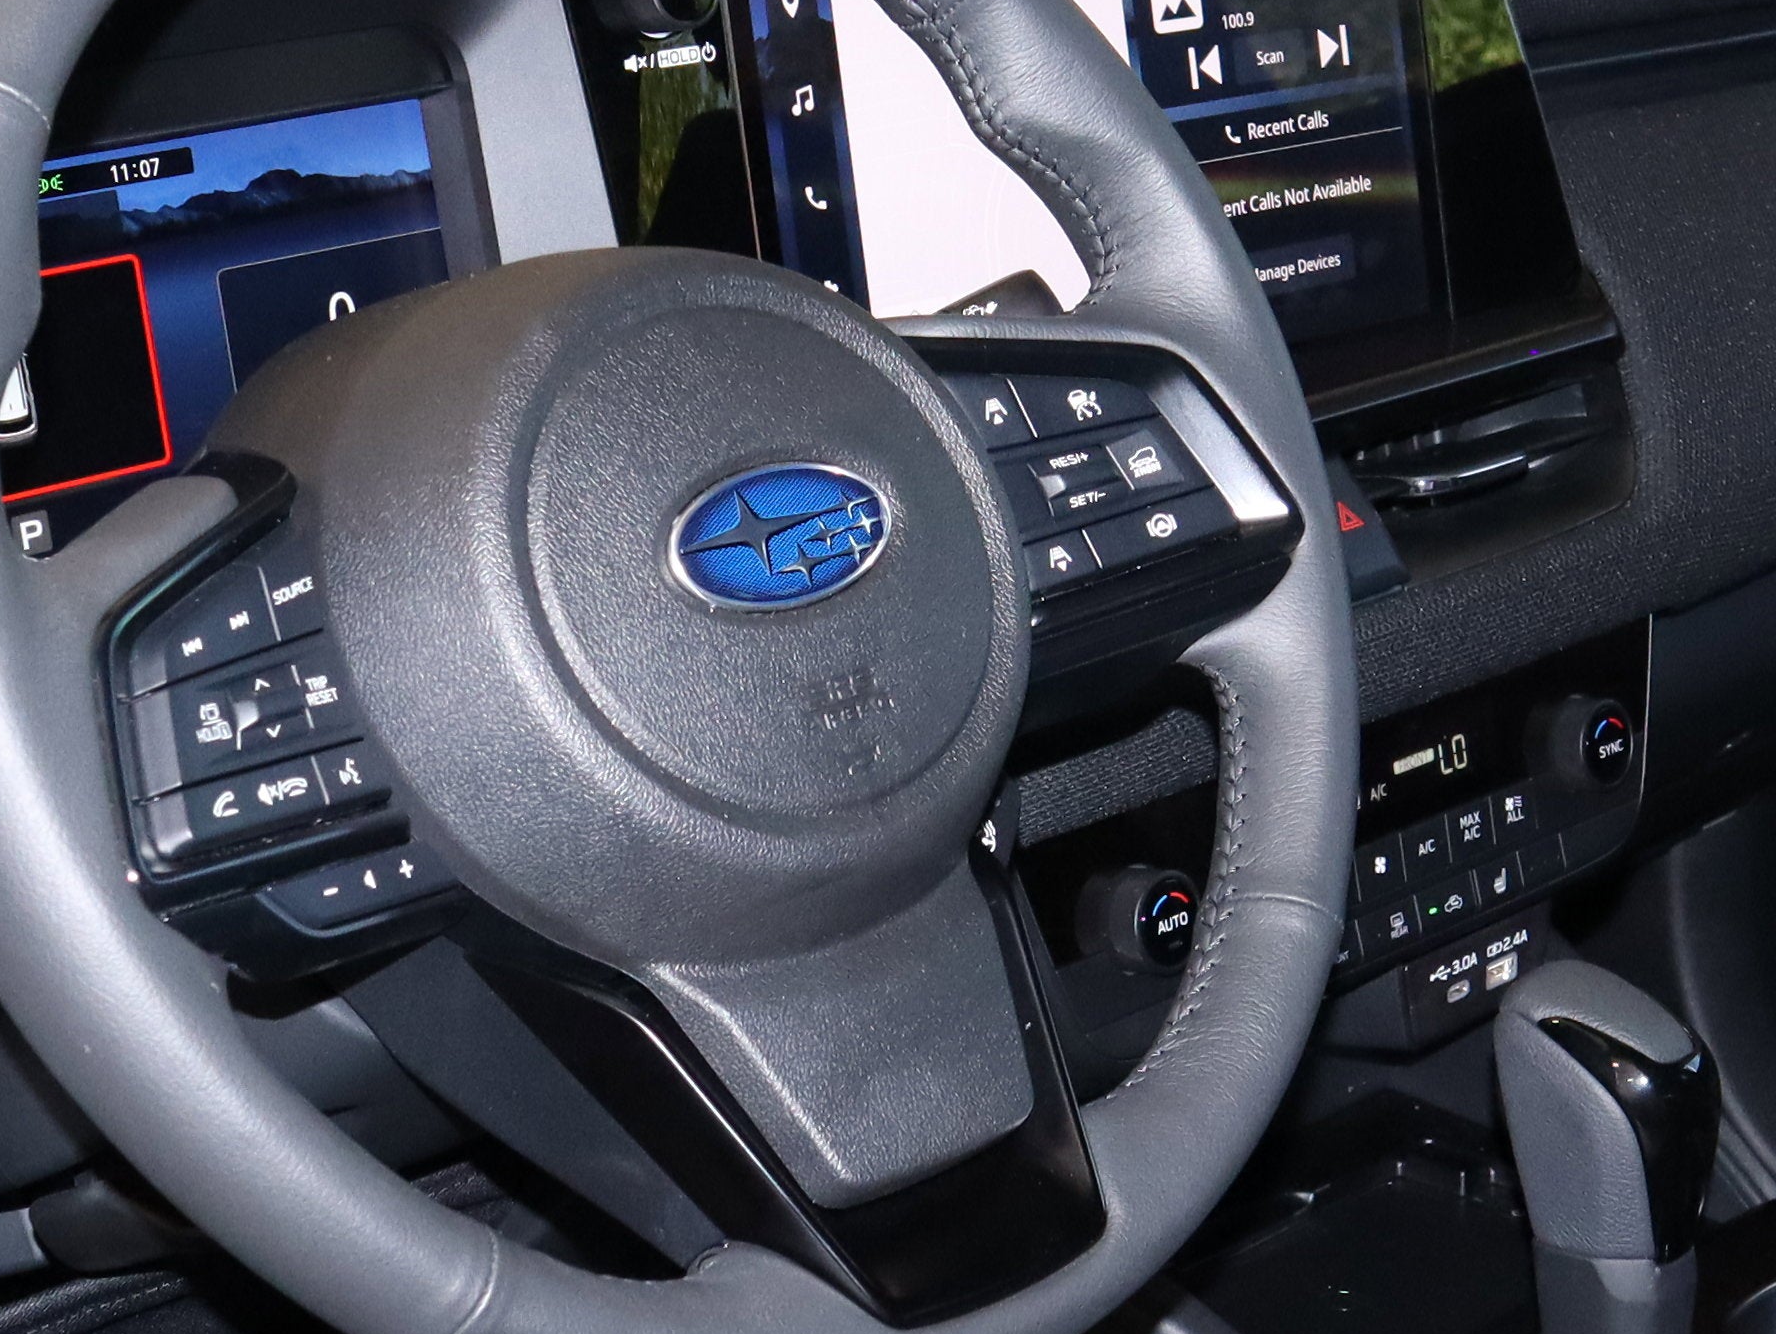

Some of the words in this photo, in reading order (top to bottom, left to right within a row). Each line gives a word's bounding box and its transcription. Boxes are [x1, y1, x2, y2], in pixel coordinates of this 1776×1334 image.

[1221, 11, 1255, 31] 100.9
[1256, 49, 1285, 66] Scan
[1247, 117, 1295, 141] Recent
[1297, 109, 1329, 132] Calls
[109, 156, 161, 184] 11:07
[1222, 199, 1247, 218] ent
[1249, 191, 1282, 213] Calls
[1284, 188, 1311, 207] Not
[1312, 174, 1373, 201] Available
[1297, 253, 1342, 273] Devices
[19, 519, 44, 551] P
[272, 576, 315, 607] SOURCE
[304, 674, 328, 692] TRIP
[305, 687, 339, 707] RESET
[1598, 738, 1625, 759] SYNC
[1370, 783, 1387, 801] A/C
[1459, 810, 1482, 830] MAX
[1506, 808, 1525, 825] ALL
[1463, 825, 1481, 843] A/C
[1418, 839, 1436, 857] A/C
[1157, 911, 1189, 936] AUTO
[1503, 929, 1529, 951] 2.4A
[1451, 951, 1478, 975] 3.0A
